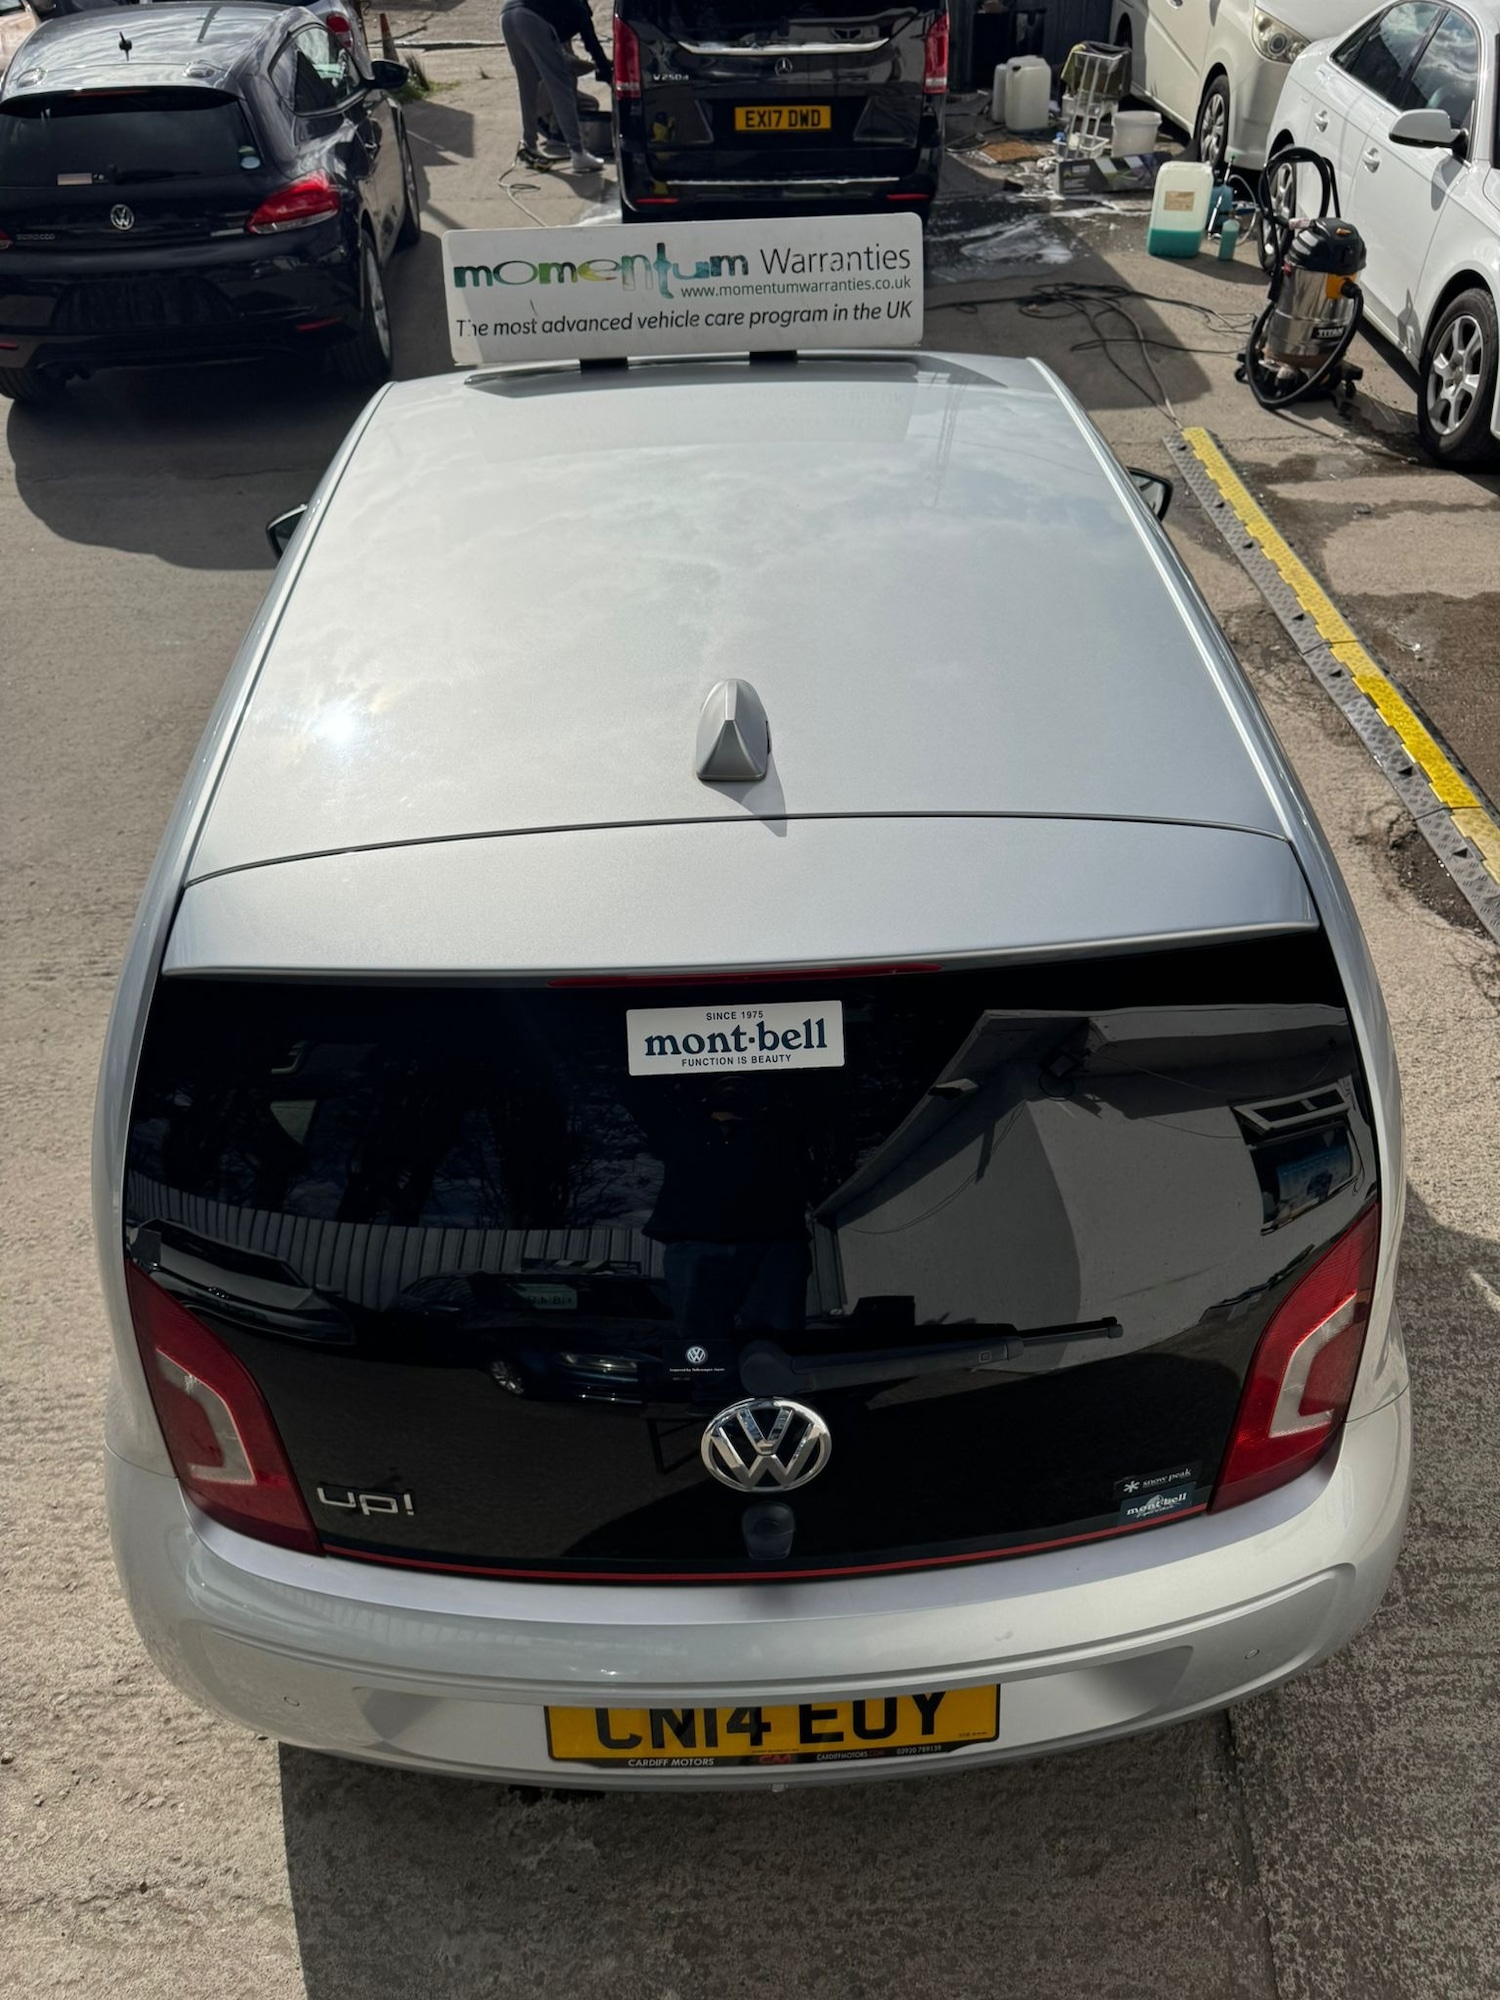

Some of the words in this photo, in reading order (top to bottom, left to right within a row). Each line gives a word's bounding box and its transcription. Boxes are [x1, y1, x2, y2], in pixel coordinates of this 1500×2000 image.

[745, 109, 783, 128] EX17
[787, 109, 821, 128] DWD
[453, 242, 749, 299] momentum
[760, 243, 911, 275] Warranties
[681, 275, 912, 298] www.momentumwarranties.co.uk
[493, 318, 538, 336] most
[541, 312, 633, 333] advanced
[637, 310, 700, 329] vehicle
[704, 310, 744, 327] care
[749, 307, 829, 329] program
[833, 304, 848, 322] in
[853, 302, 882, 320] the
[887, 300, 914, 319] UK
[705, 1011, 738, 1021] SINCE
[741, 1010, 764, 1020] 1975
[681, 1056, 734, 1067] FUNCTION
[737, 1056, 748, 1065] IS
[751, 1054, 792, 1064] BEAUTY
[316, 1487, 414, 1515] up!
[595, 1706, 772, 1749] CN14
[628, 1758, 669, 1767] CARDIFF
[671, 1757, 714, 1767] MOTORS
